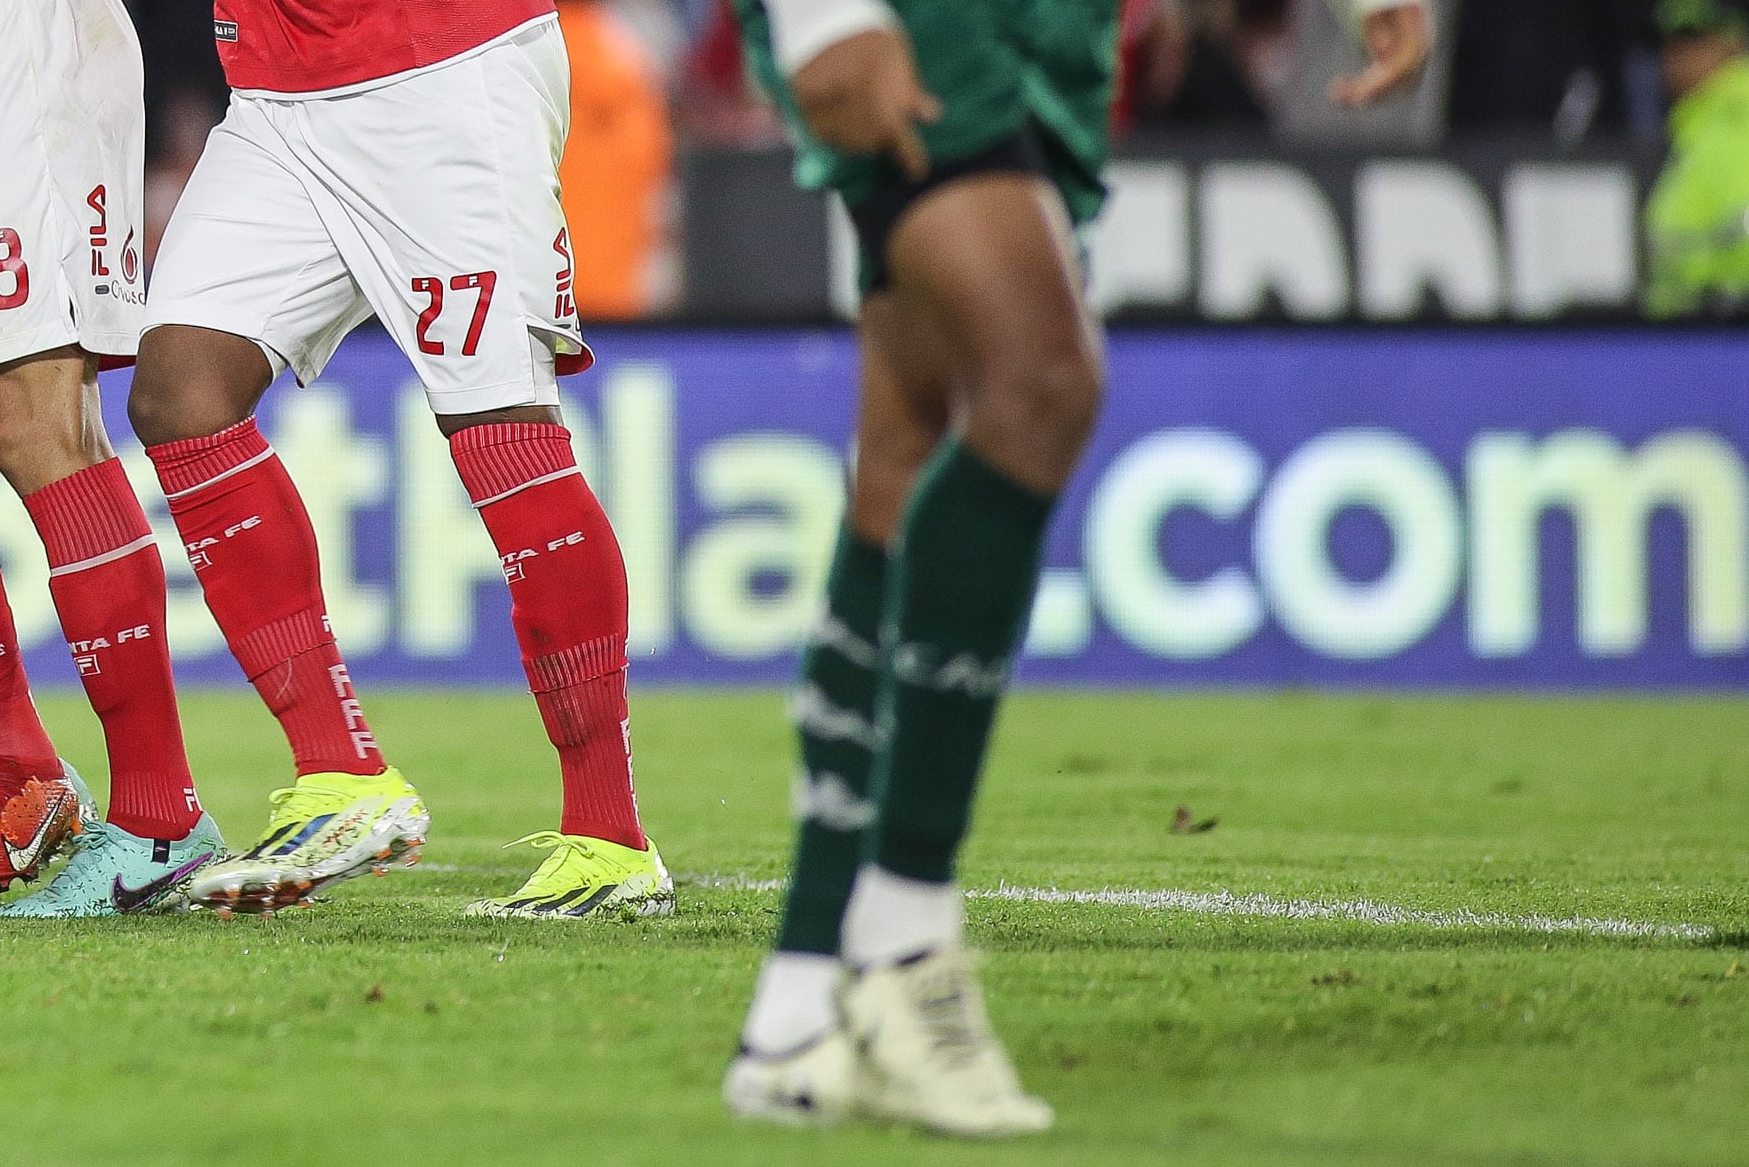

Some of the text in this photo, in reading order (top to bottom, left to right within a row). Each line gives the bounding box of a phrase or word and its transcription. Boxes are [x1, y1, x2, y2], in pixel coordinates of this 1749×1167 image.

[86, 184, 110, 276] FILA
[553, 226, 576, 320] FILA
[410, 270, 497, 357] 27
[224, 515, 263, 538] FE
[547, 531, 586, 551] FE
[117, 623, 151, 644] FE
